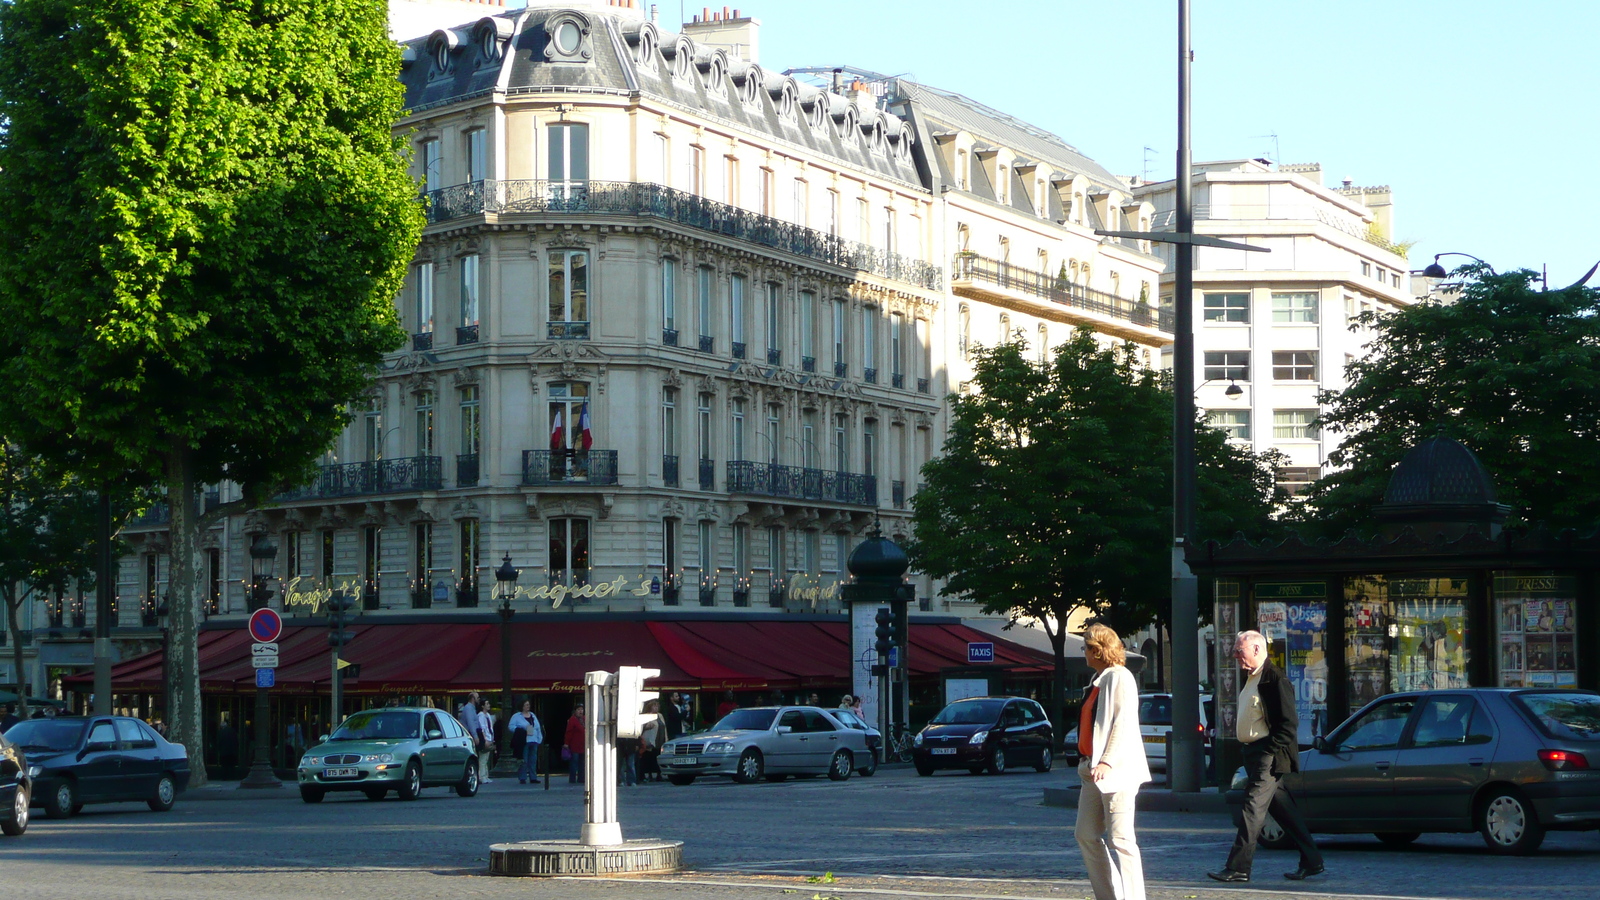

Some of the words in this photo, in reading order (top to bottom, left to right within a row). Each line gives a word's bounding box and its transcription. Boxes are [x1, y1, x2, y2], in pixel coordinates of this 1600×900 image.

[1515, 578, 1559, 591] PRESSE
[285, 577, 361, 614] Fouqut's
[527, 650, 615, 659] Fouquet's
[970, 648, 992, 657] TAXIS
[1291, 670, 1300, 678] Les
[381, 683, 424, 693] Fouquet's
[1291, 678, 1327, 702] 100
